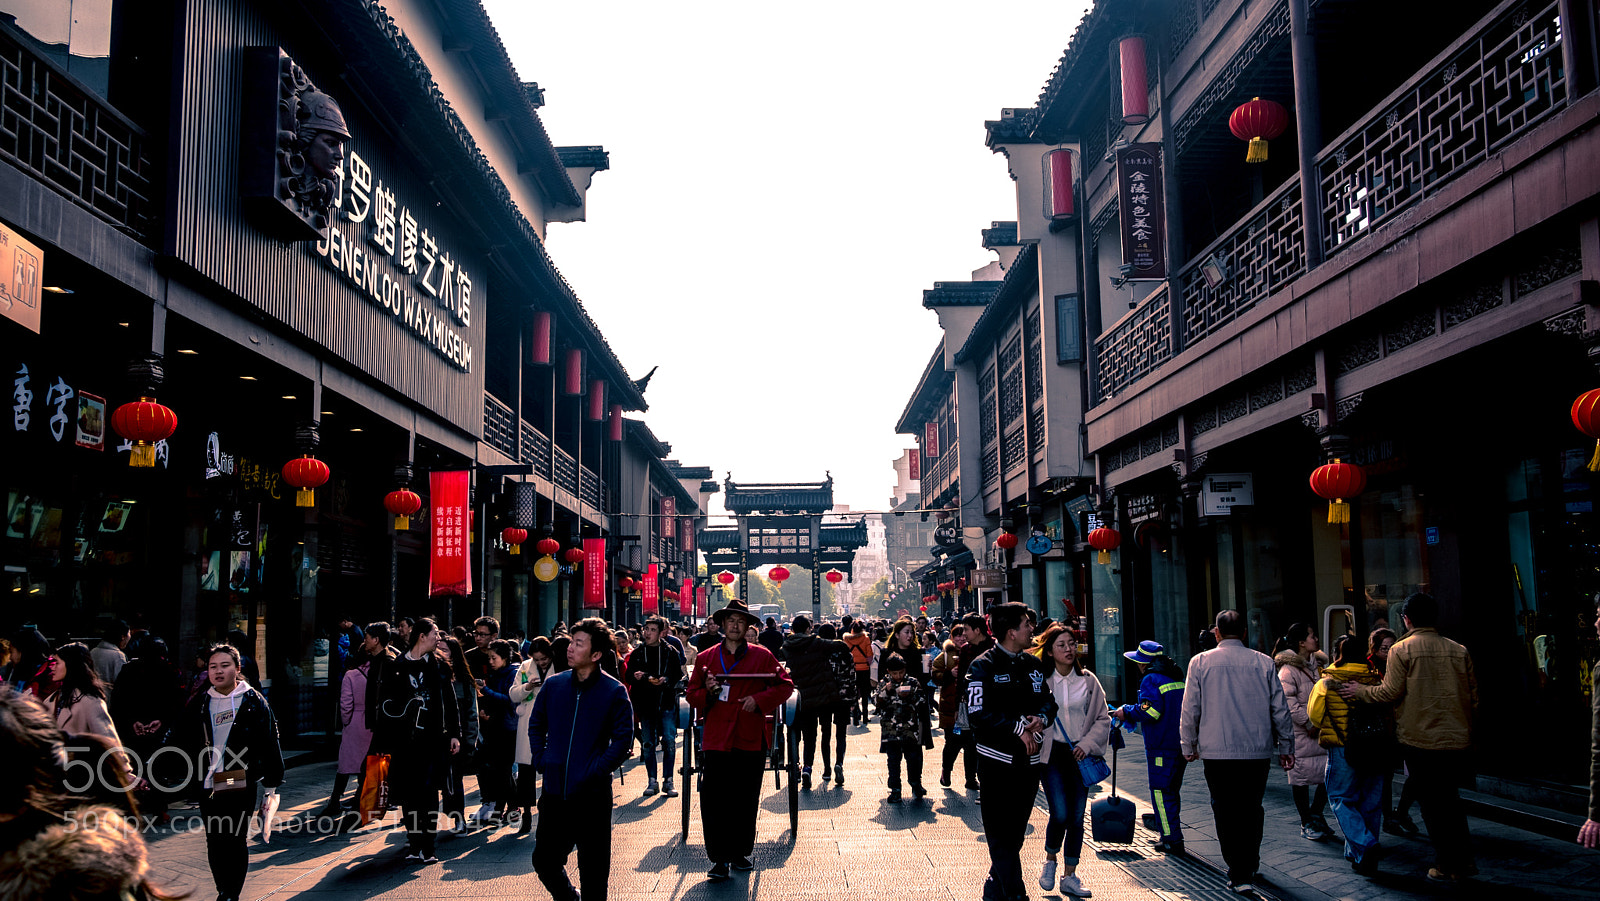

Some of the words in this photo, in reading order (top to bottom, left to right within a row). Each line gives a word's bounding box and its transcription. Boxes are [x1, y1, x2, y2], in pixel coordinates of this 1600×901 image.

[1128, 170, 1152, 241] 金陵特色美食
[404, 290, 431, 341] WAX
[432, 315, 472, 374] MUSEUM
[436, 506, 444, 558] 续写新篇章
[445, 506, 453, 557] 开启新征程
[454, 505, 462, 557] 迈进新时代
[967, 686, 984, 707] 72
